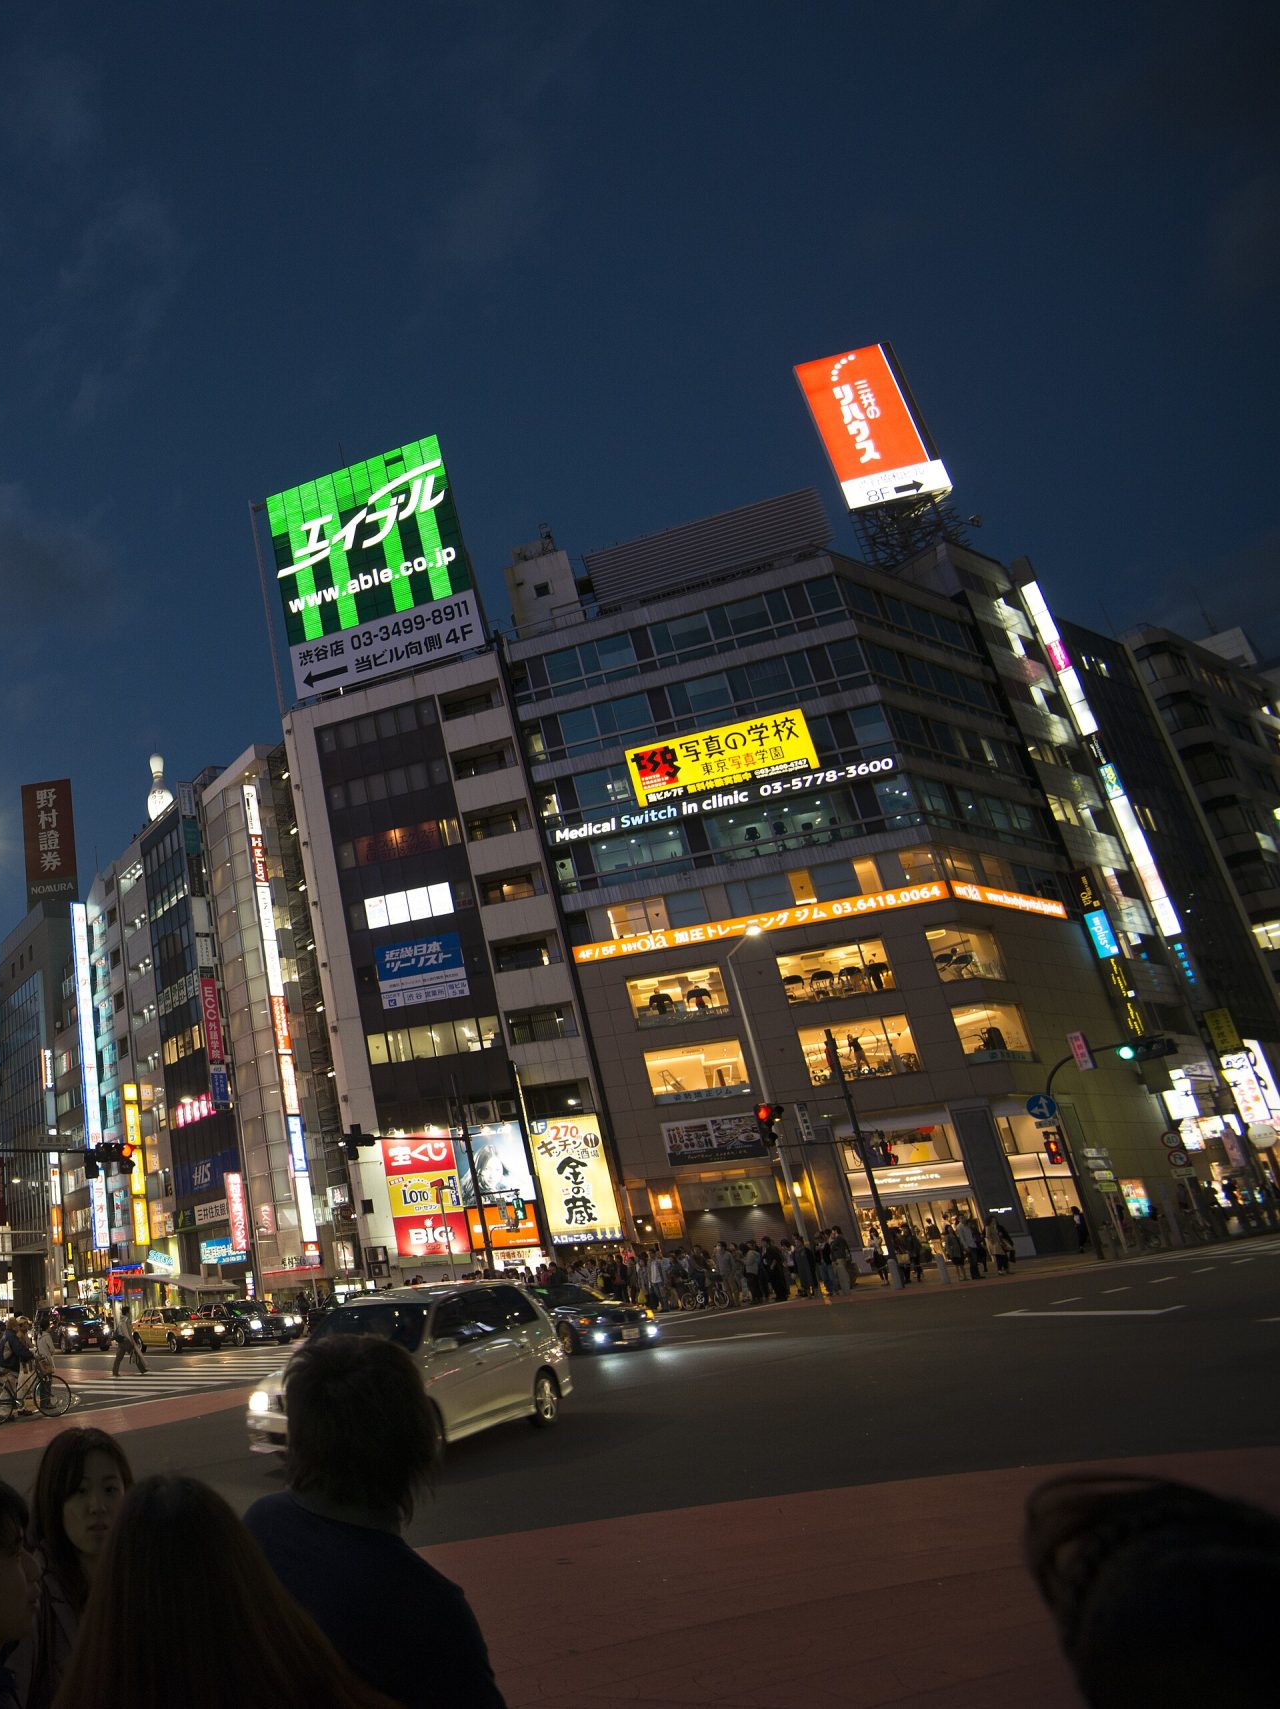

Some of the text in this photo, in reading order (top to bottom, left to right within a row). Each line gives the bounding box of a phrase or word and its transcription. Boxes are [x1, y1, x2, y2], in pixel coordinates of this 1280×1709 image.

[854, 378, 881, 421] 三井の
[831, 384, 881, 465] リハウス
[866, 487, 893, 503] 8F
[277, 458, 446, 579] エイブル
[288, 546, 457, 615] www.able.co.jp
[298, 600, 471, 667] 渋谷店 03-3499-8911
[354, 623, 475, 674] 当ビル向側 4F
[679, 717, 799, 764] 写真の学校
[701, 746, 786, 777] 東京写真学園
[555, 818, 616, 844] Medical
[621, 805, 678, 829] Switch
[682, 800, 698, 816] in
[701, 789, 750, 812] clinic
[759, 757, 895, 799] 03-5778-3600
[647, 787, 685, 803] 当ビル7F
[36, 787, 63, 873] 野村證券
[30, 881, 76, 896] NOMURA
[795, 907, 828, 923] ジム
[832, 885, 941, 915] 03.6418.0064
[384, 941, 442, 962] 近畿日本
[385, 952, 452, 973] ツーリスト
[407, 988, 445, 1001] 渋谷営業所
[203, 985, 221, 1061] ECC外語学院
[530, 1121, 546, 1135] 1F
[551, 1125, 580, 1141] 270
[388, 1142, 448, 1167] 宝くじ
[537, 1139, 583, 1158] キッチン
[577, 1148, 601, 1160] 酒場
[402, 1188, 429, 1206] LOTO
[556, 1156, 598, 1226] 金の蔵
[196, 1205, 228, 1222] 三井住友銀
[408, 1226, 456, 1245] BIG
[553, 1232, 595, 1245] 入口はこちら
